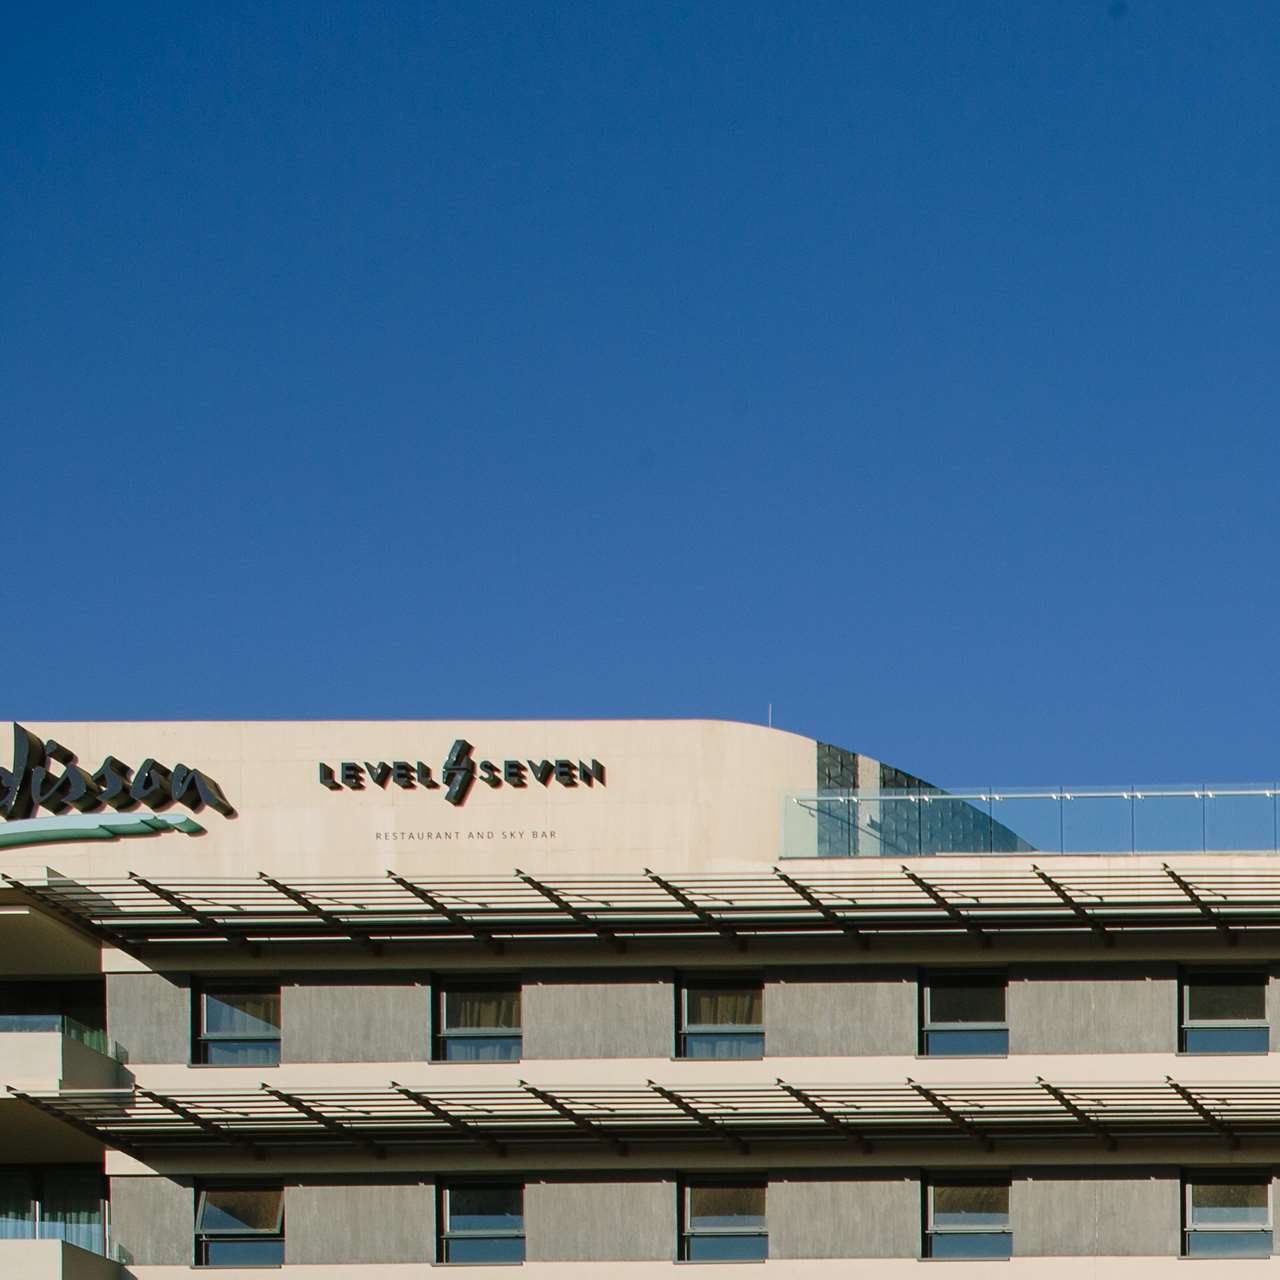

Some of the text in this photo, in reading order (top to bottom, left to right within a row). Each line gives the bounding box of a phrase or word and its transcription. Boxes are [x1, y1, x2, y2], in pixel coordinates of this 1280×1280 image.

[318, 758, 606, 790] LEVEL SEVEN
[375, 830, 557, 841] RESTAURANT AND SKY BAR
